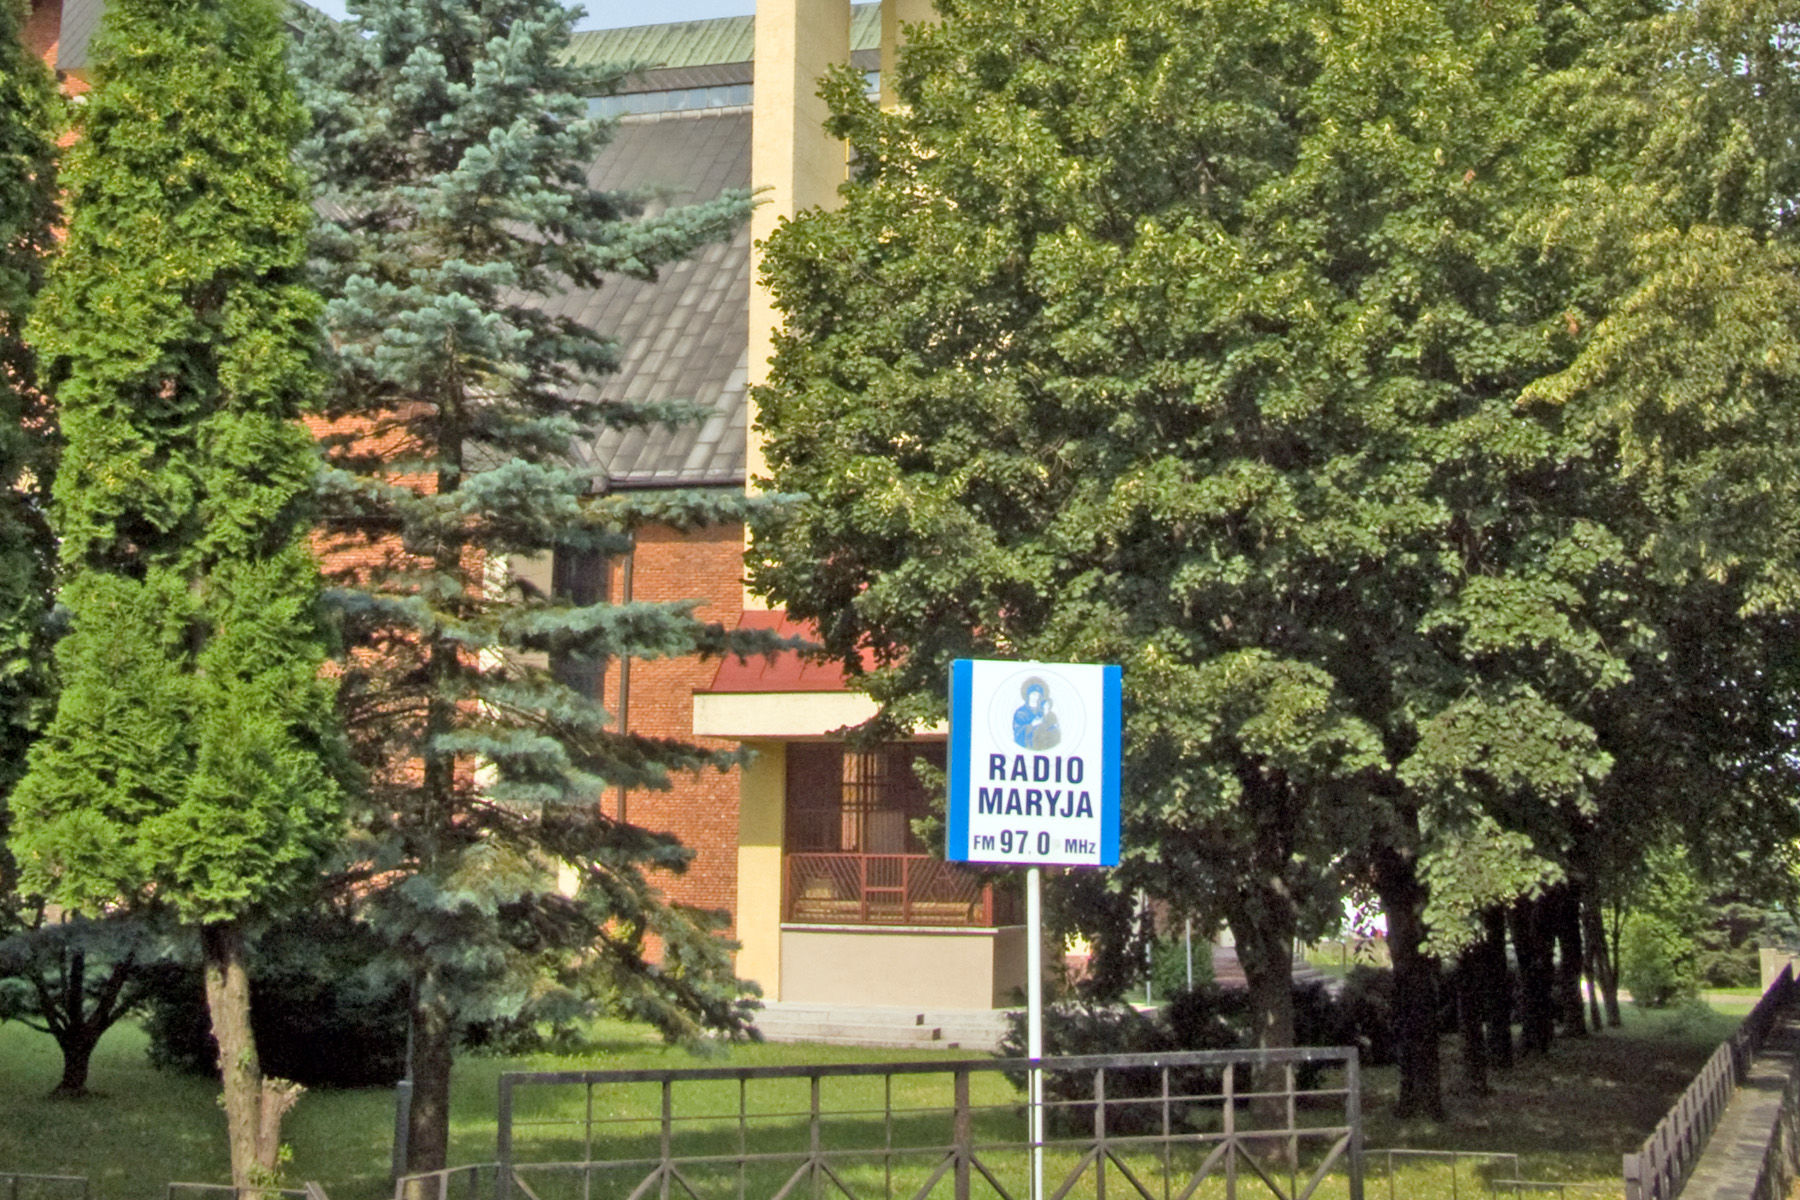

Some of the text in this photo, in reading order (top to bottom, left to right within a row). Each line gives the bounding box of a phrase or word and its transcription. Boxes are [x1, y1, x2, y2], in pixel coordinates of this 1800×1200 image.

[989, 753, 1084, 784] RADIO
[978, 787, 1094, 818] MARYJA
[973, 835, 995, 850] FM
[1064, 838, 1096, 854] MHz
